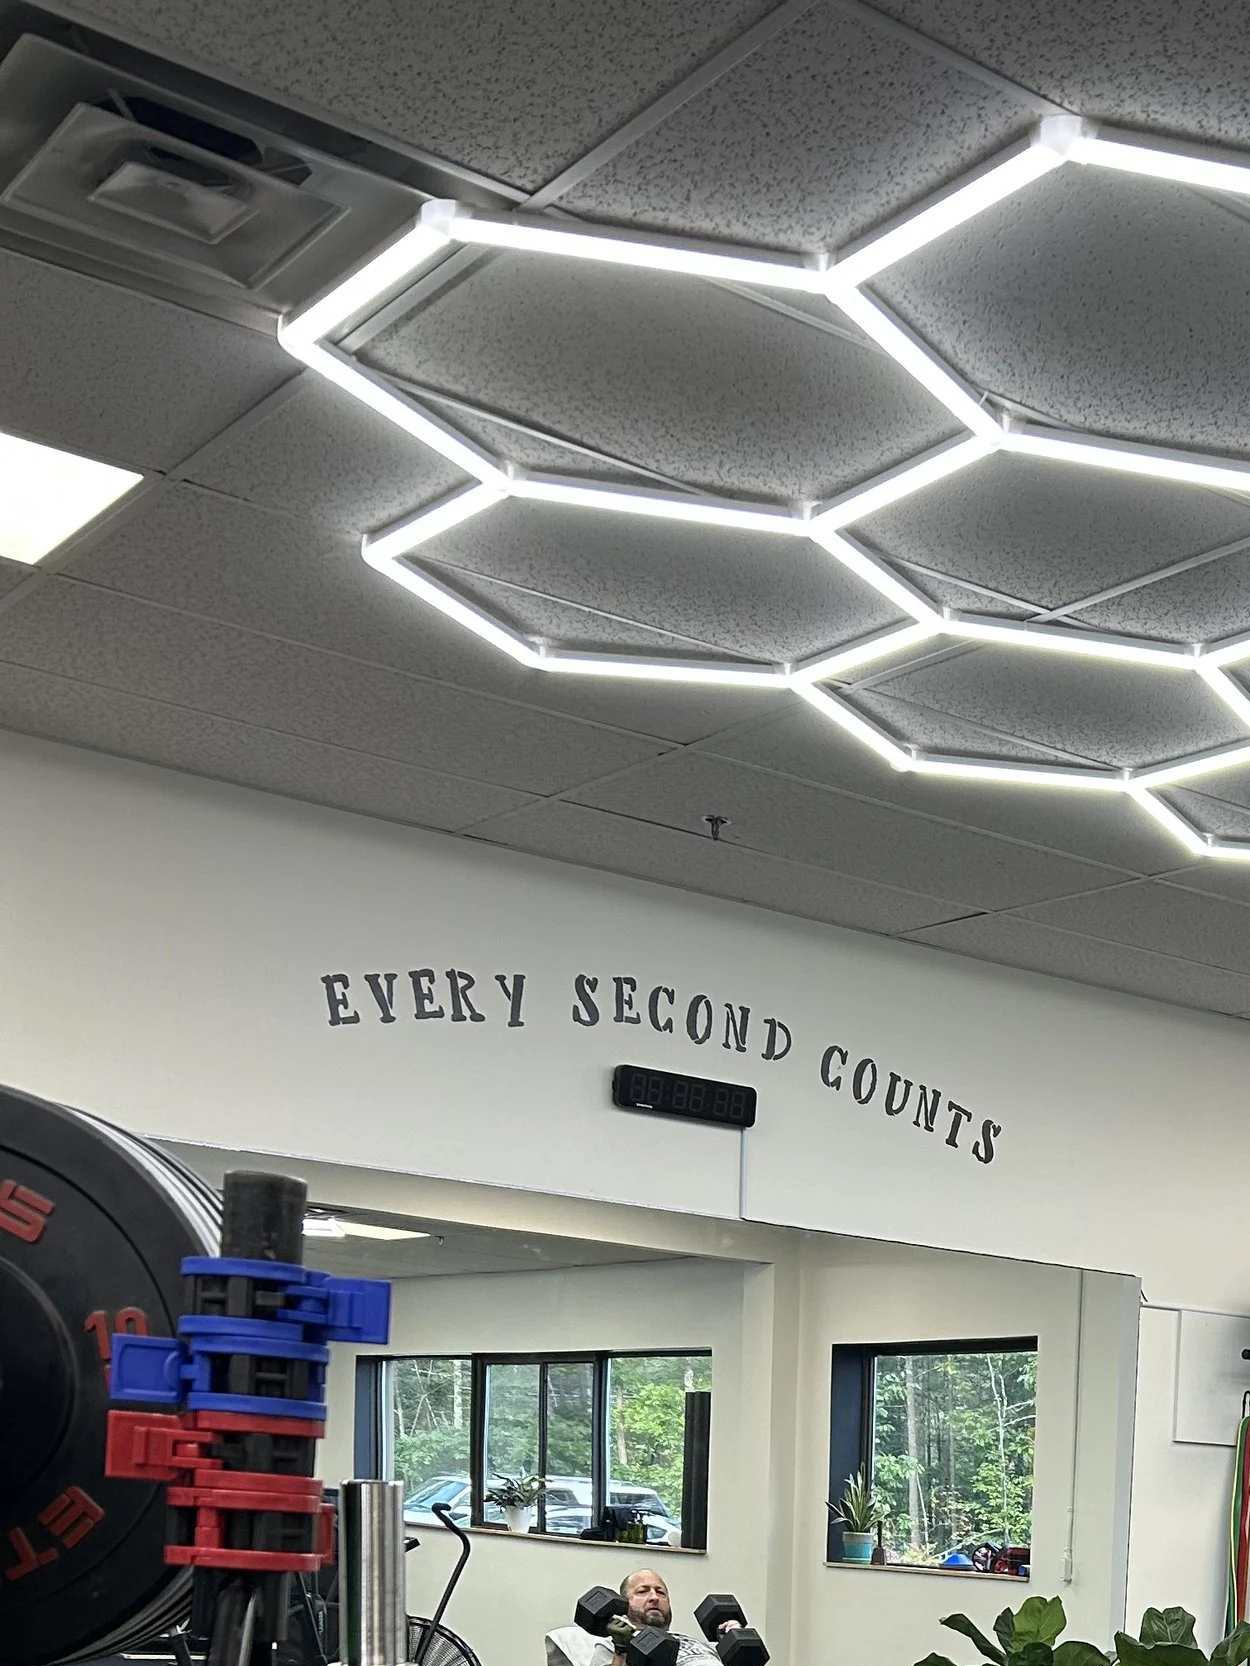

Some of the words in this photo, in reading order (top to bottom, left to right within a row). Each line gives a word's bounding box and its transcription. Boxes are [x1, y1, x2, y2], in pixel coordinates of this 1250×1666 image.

[321, 968, 526, 1027] EVERY
[572, 974, 792, 1061] SECOND
[820, 1045, 1002, 1164] COUNTS
